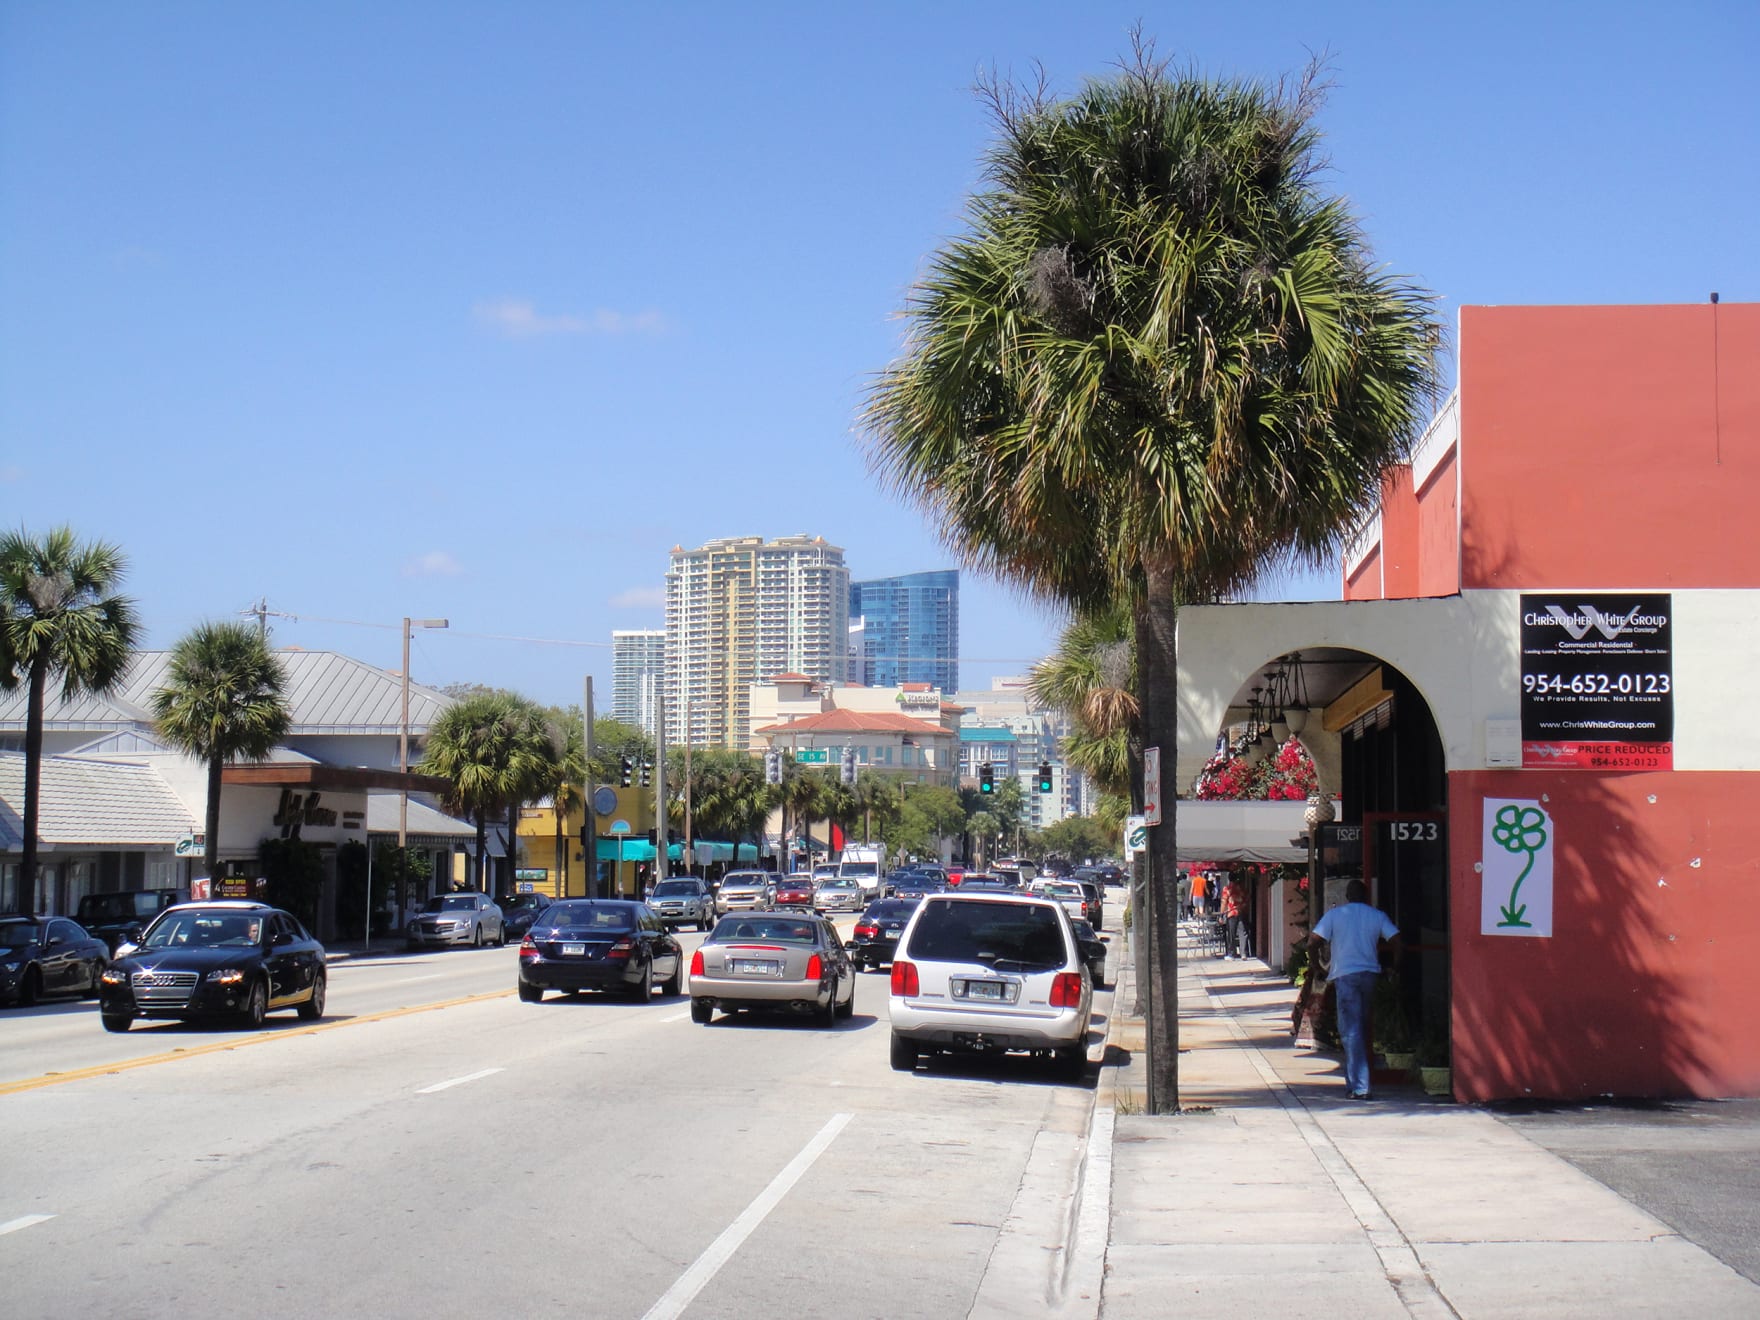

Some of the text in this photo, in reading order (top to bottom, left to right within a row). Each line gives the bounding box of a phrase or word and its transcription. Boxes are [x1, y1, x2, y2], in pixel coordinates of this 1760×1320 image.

[1523, 674, 1671, 694] 954-652-0123
[1539, 721, 1656, 730] www.ChrisWhiteGroup.com
[1578, 745, 1671, 754] PRICE REDUCED
[1591, 758, 1658, 767] 954-652-0123
[1390, 822, 1438, 841] 1523
